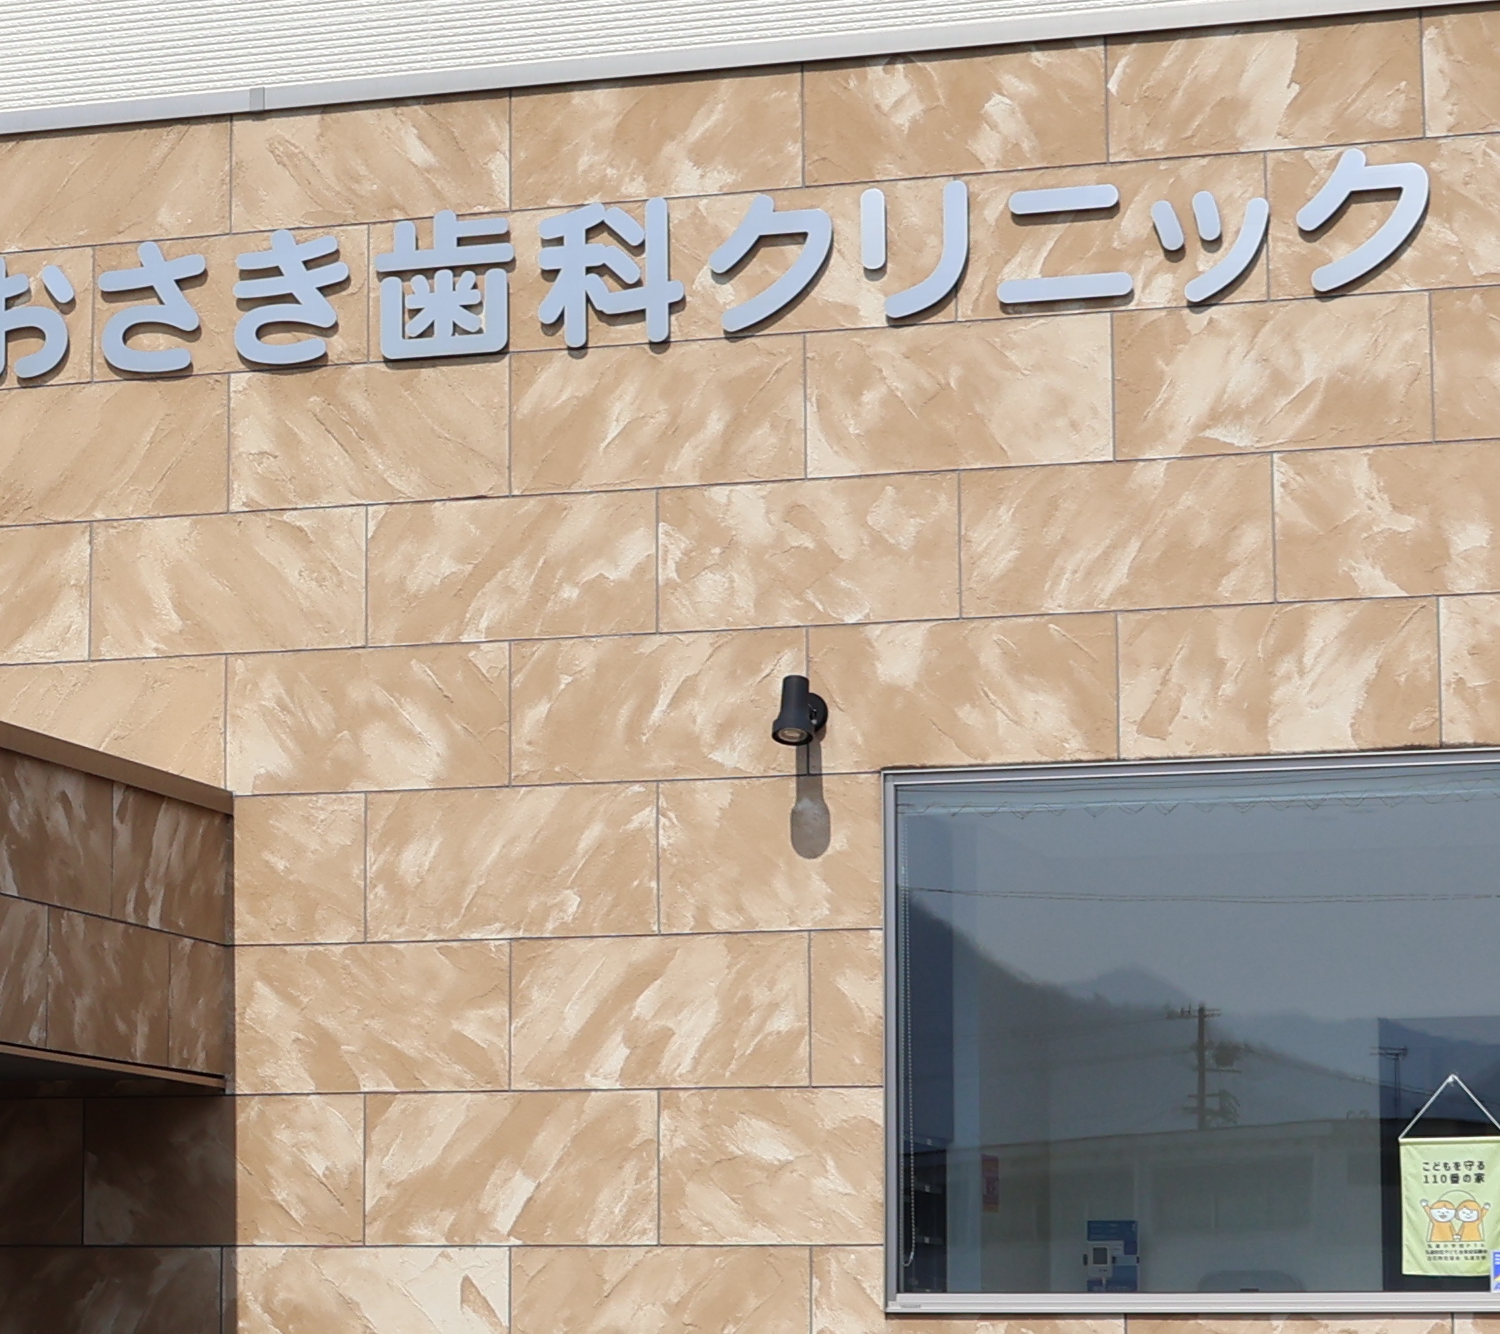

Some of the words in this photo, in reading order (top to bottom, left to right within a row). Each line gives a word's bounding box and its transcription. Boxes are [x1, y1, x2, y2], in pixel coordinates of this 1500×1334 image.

[1422, 1160, 1486, 1172] こどもを守る
[1423, 1173, 1486, 1184] 110番の家
